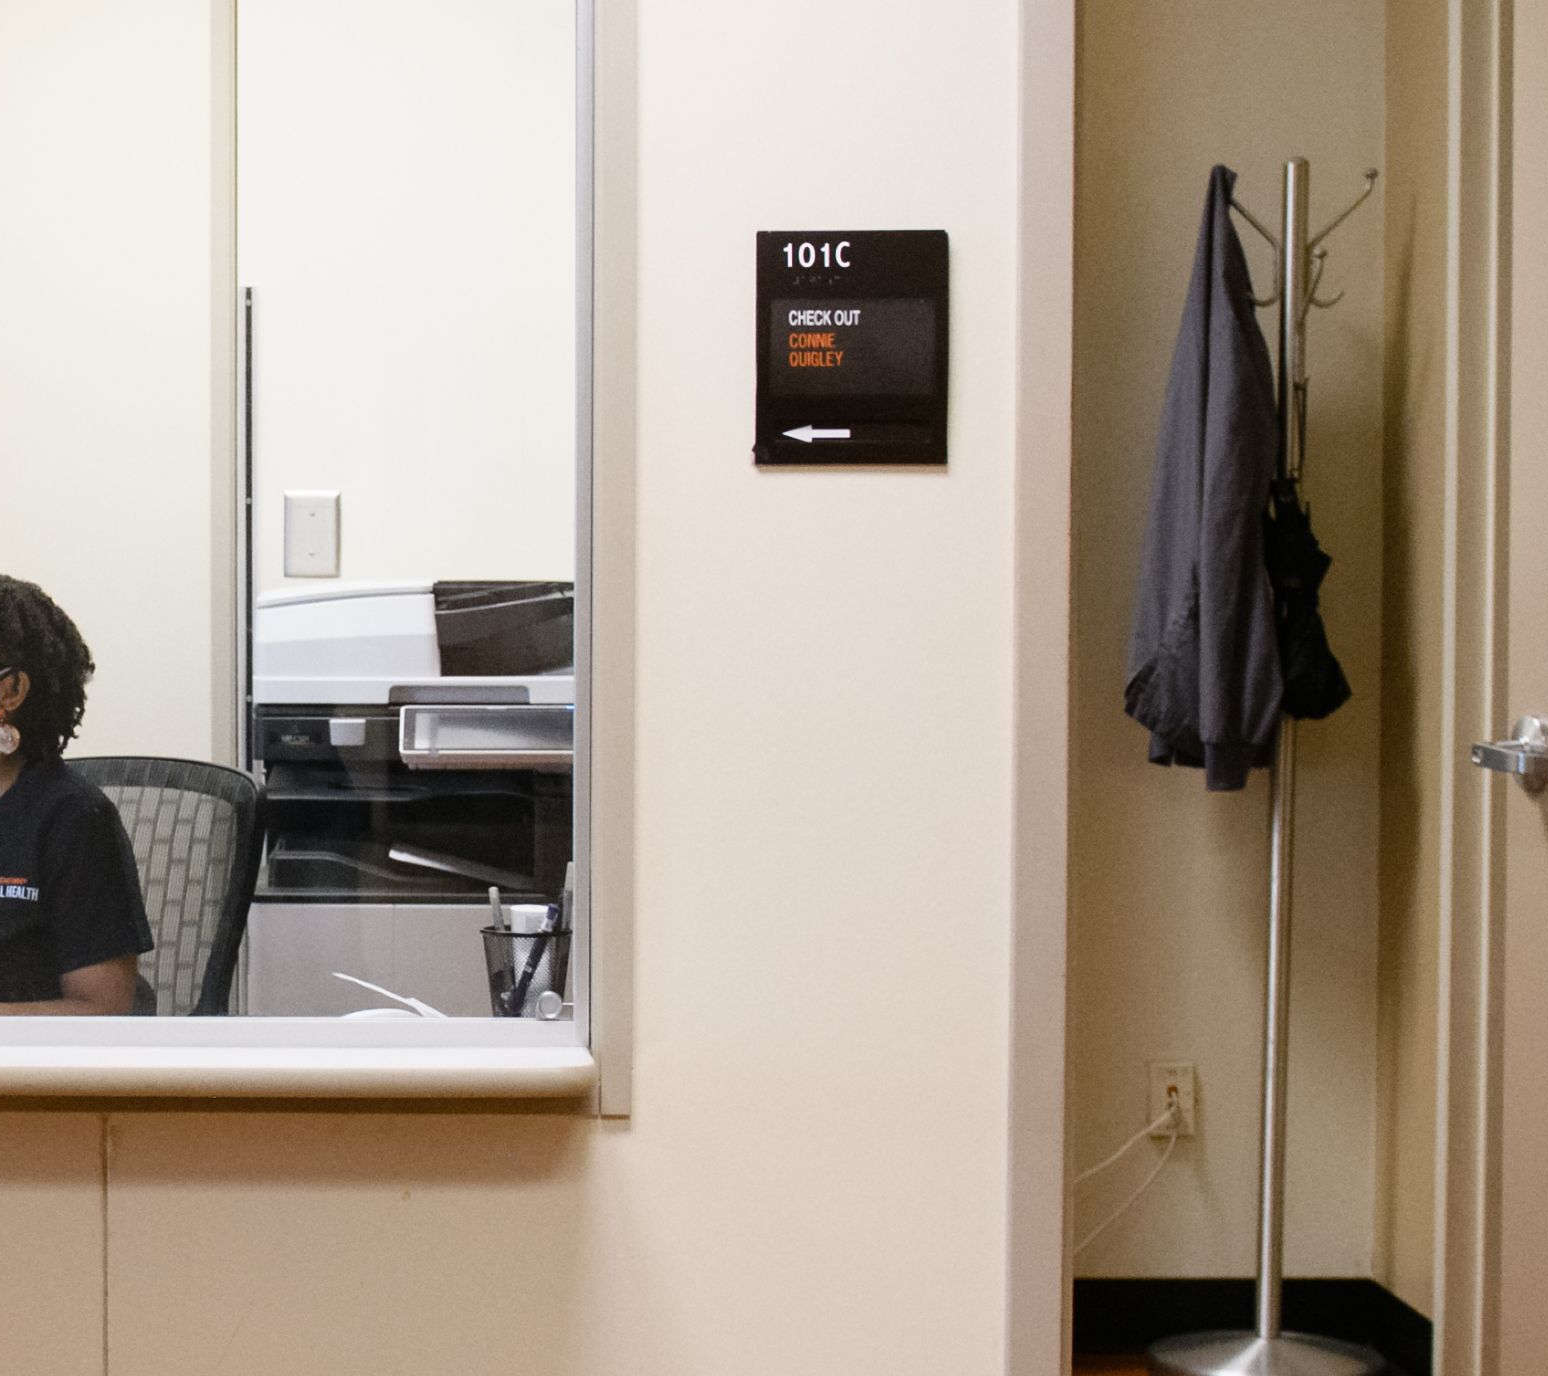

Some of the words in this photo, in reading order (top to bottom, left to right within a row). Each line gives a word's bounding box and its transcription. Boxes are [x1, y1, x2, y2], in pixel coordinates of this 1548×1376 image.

[782, 241, 851, 268] 101C
[788, 310, 832, 326] CHECK
[834, 310, 861, 326] OUT
[789, 332, 836, 349] CONNIE
[789, 351, 844, 367] QUIGLEY
[6, 885, 39, 901] HEALTH
